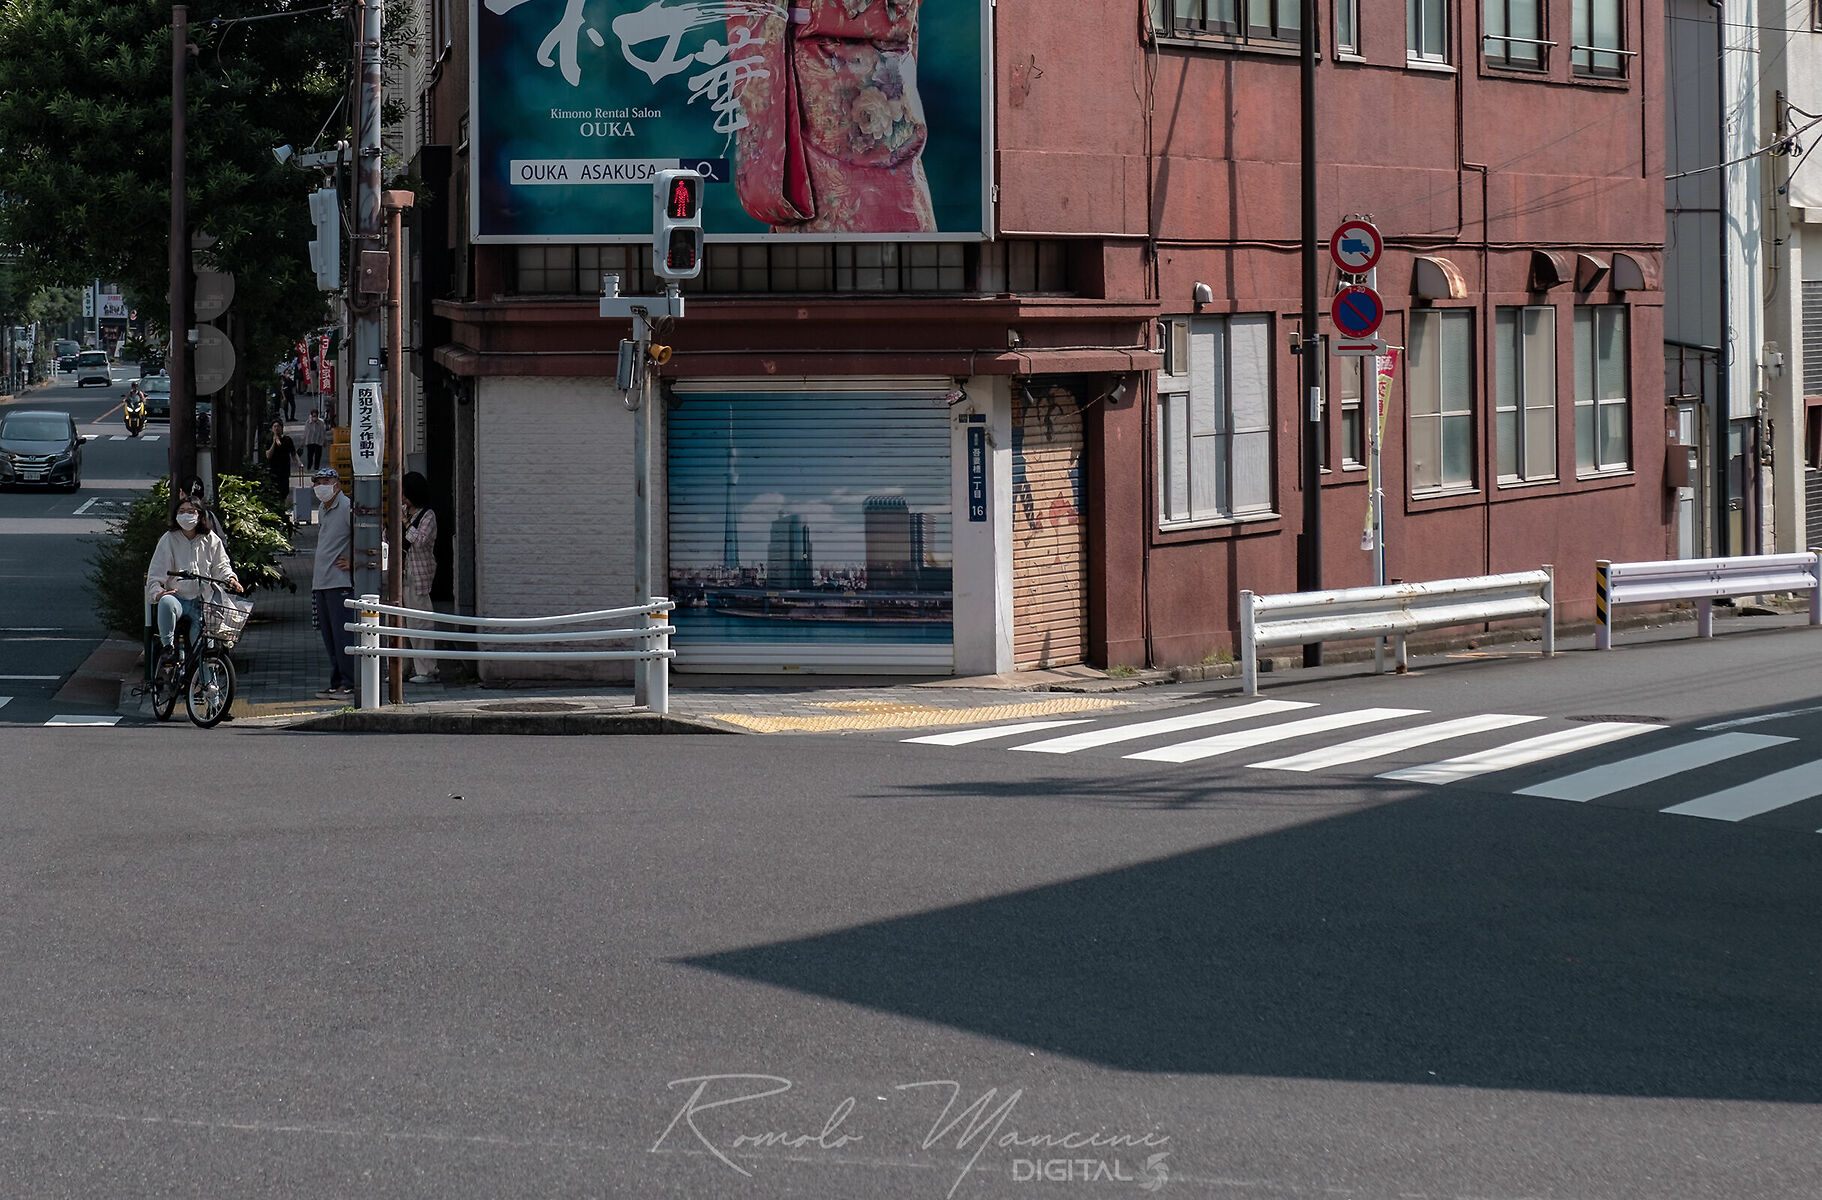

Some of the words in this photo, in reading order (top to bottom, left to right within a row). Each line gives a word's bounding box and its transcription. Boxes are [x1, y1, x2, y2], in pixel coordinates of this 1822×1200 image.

[550, 108, 593, 119] Kimono
[595, 107, 629, 119] Rental
[632, 107, 662, 119] Salon
[579, 122, 636, 138] OUKA
[520, 164, 569, 181] OUKA
[580, 161, 656, 180] ASAKUSA
[358, 388, 375, 459] 防犯カメラ作動中
[972, 505, 984, 516] 16
